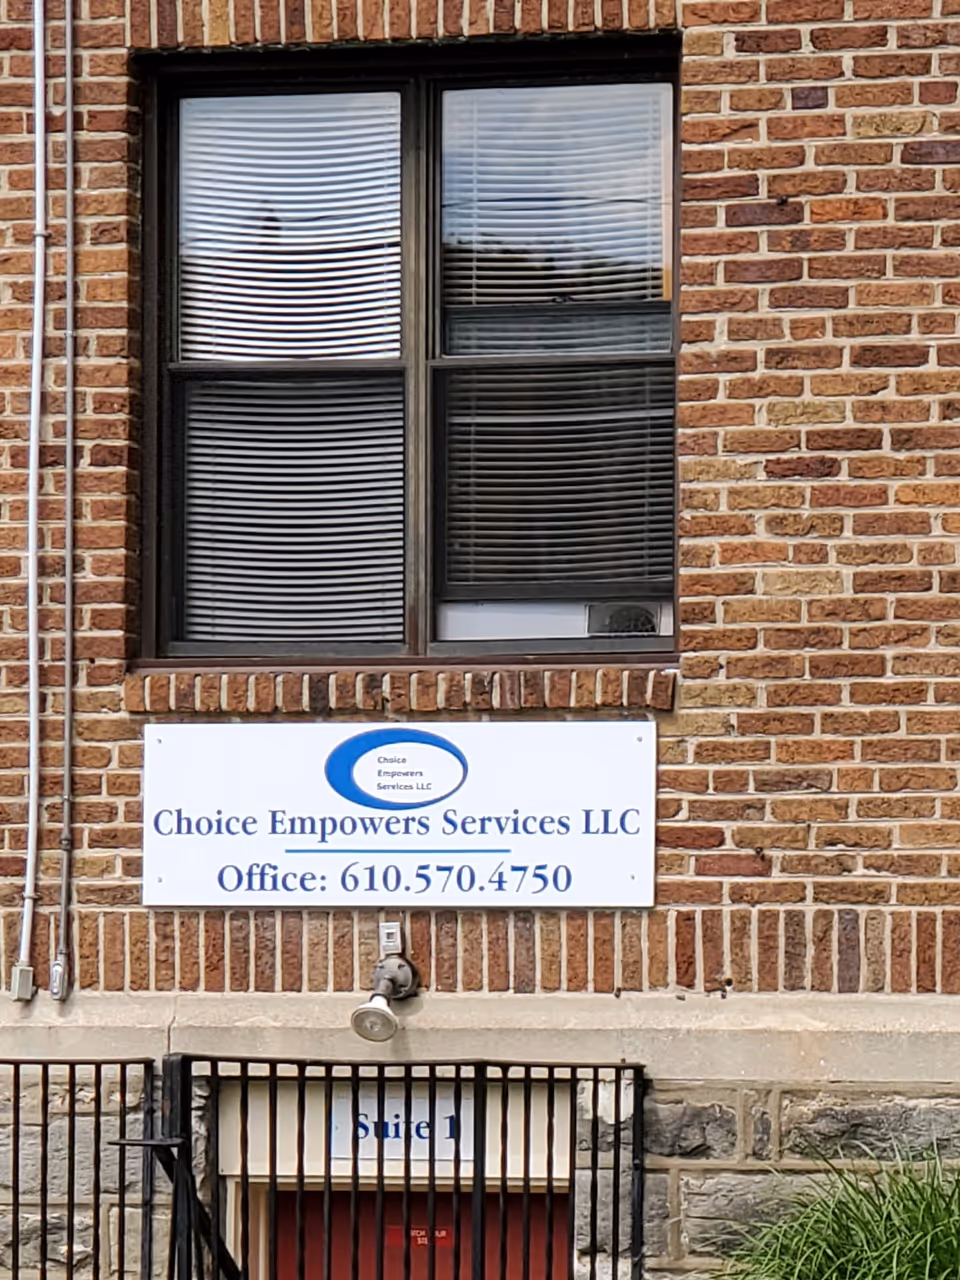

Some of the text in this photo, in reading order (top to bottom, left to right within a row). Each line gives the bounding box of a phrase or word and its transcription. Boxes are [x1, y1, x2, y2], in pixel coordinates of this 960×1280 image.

[377, 756, 407, 764] Choice
[377, 769, 424, 779] Empowers
[376, 782, 432, 791] Services LLC
[153, 807, 641, 844] Choice Empowers Services LLC
[217, 862, 573, 895] Office: 610.570.4750
